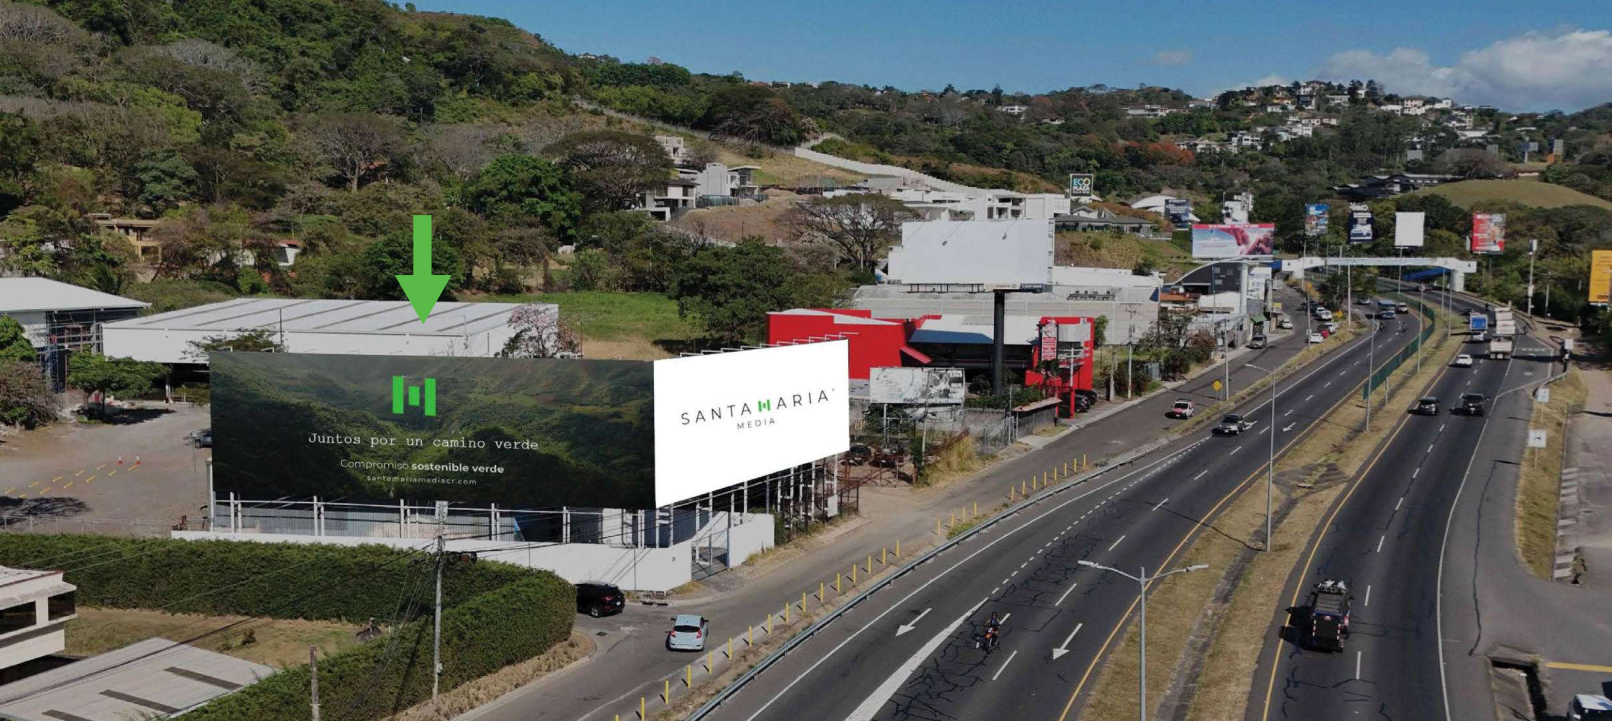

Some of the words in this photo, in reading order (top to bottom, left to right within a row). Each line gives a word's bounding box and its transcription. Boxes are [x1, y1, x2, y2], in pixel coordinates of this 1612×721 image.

[1073, 178, 1091, 186] ECO
[737, 417, 776, 430] MEDIA
[308, 433, 361, 444] Juntos
[370, 437, 396, 447] por
[406, 438, 423, 446] un
[433, 437, 485, 448] camino
[495, 440, 539, 450] verde
[340, 459, 409, 470] Compromiso
[411, 462, 469, 472] sostenible
[472, 464, 505, 473] verde
[366, 475, 477, 485] santamariamediacr.com
